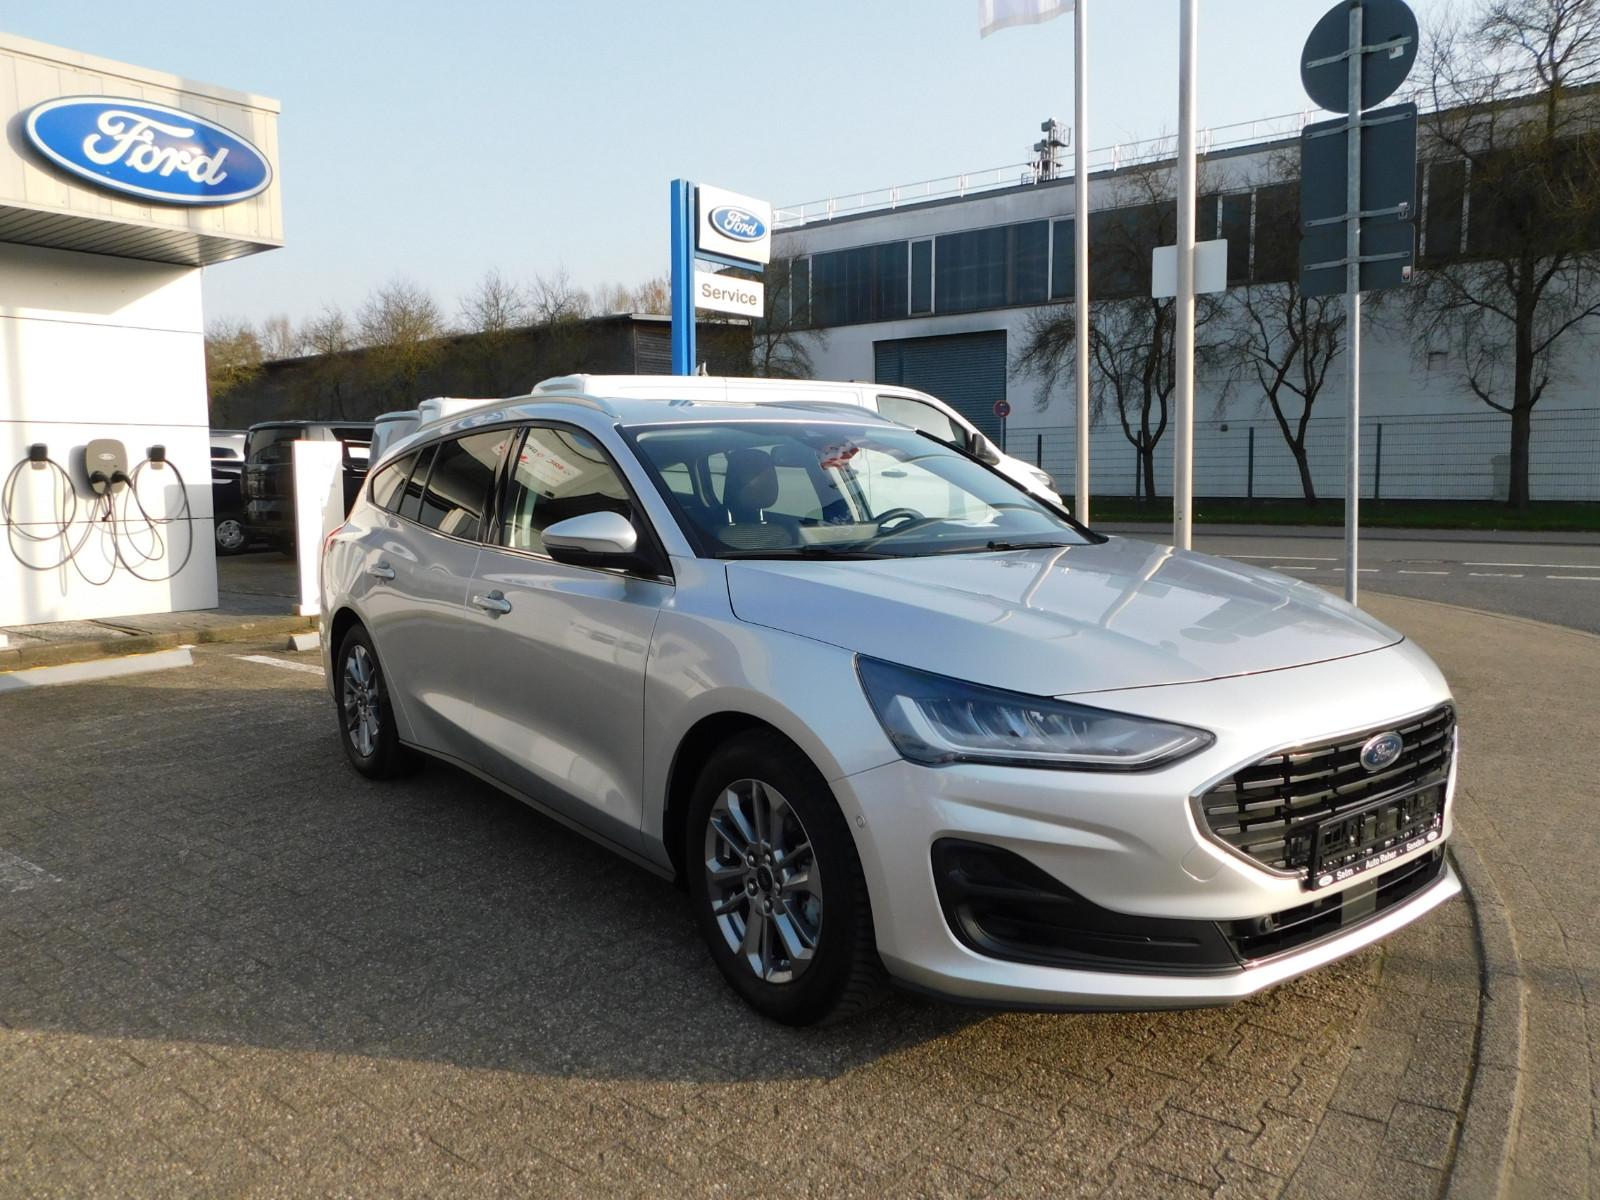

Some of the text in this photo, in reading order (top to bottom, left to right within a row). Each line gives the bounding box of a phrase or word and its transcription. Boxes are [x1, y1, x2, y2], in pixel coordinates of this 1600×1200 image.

[83, 110, 229, 186] Ford
[724, 210, 758, 236] Ford
[701, 283, 757, 306] Service
[1365, 857, 1380, 870] Auto
